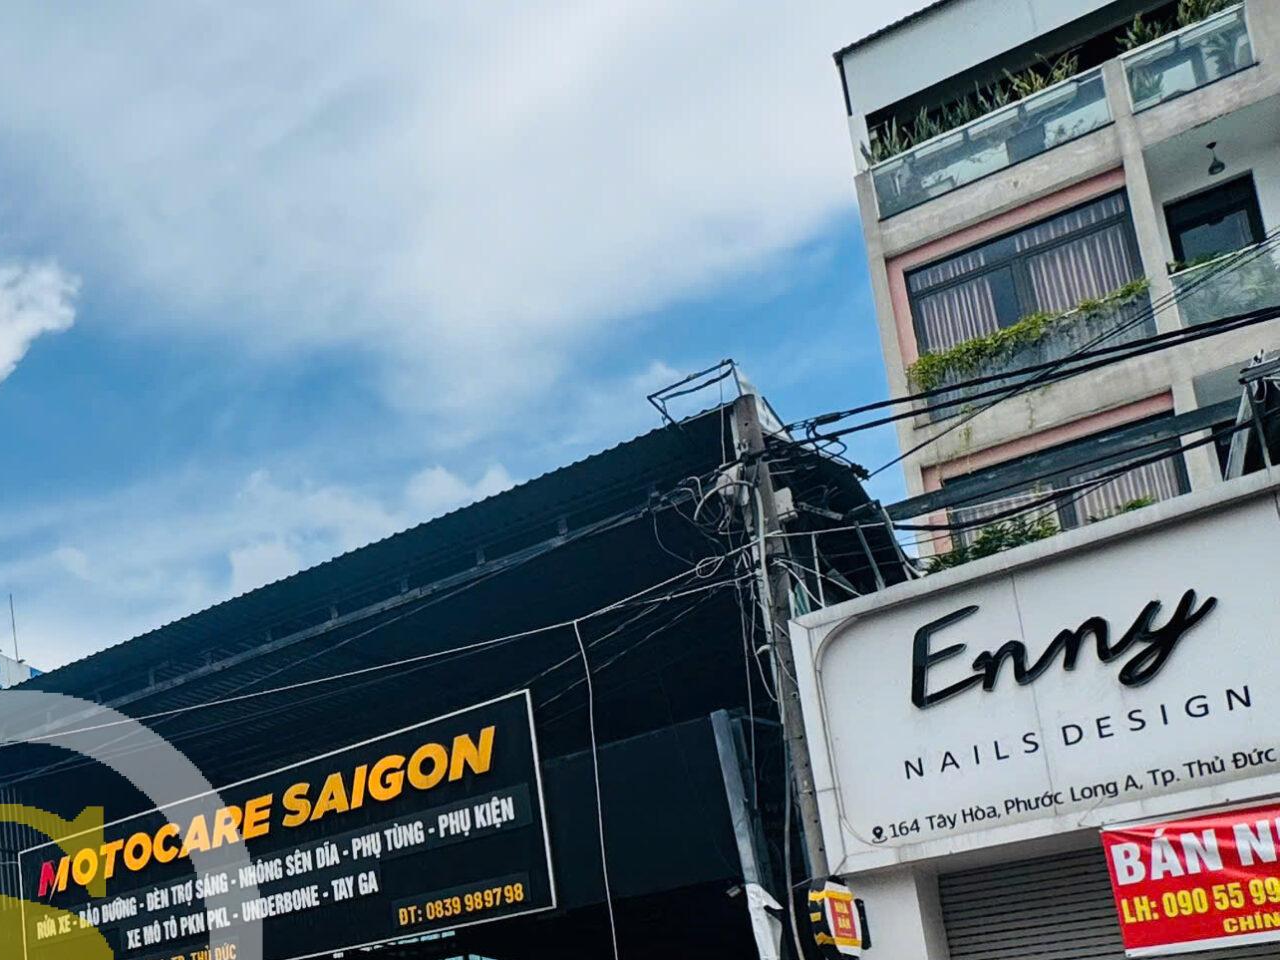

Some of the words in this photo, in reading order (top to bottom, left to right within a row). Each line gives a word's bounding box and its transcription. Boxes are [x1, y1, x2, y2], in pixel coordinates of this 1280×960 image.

[911, 589, 1217, 710] Enny
[904, 732, 1040, 780] NAILS
[1061, 685, 1252, 746] DESIGN
[37, 793, 273, 900] MOTOCARE
[282, 726, 495, 827] SAIGON
[889, 818, 921, 838] 164
[926, 813, 958, 830] Tây
[962, 805, 1001, 823] Hòa,
[1004, 791, 1064, 815] Phước
[1070, 781, 1118, 801] Long
[1125, 775, 1143, 791] A,
[1147, 769, 1180, 786] Tp.
[1183, 756, 1225, 778] Thủ
[1232, 748, 1277, 769] Đức
[36, 914, 57, 939] RỬA
[58, 914, 72, 935] XE
[79, 902, 100, 929] BẢO
[170, 879, 193, 906] TRỢ
[195, 873, 229, 899] SÁNG
[239, 858, 283, 889] NHÔNG
[285, 848, 313, 876] SÊN
[351, 831, 381, 860] PHỤ
[384, 822, 425, 851] TÙNG
[438, 808, 471, 837] PHỤ
[474, 796, 515, 829] KIỆN
[1111, 828, 1224, 886] BÁN
[1232, 817, 1280, 867] N
[126, 928, 142, 949] XE
[143, 920, 161, 945] MÔ
[163, 915, 177, 940] TÔ
[180, 912, 205, 937] PKN
[206, 907, 231, 930] PKL
[242, 885, 320, 922] UNDERBONE
[331, 876, 354, 901] TAY
[358, 871, 379, 895] GA
[426, 896, 461, 920] 0839
[1121, 896, 1159, 924] LH:
[1162, 888, 1209, 918] 090
[1212, 883, 1245, 910] 55
[1249, 877, 1280, 905] 99
